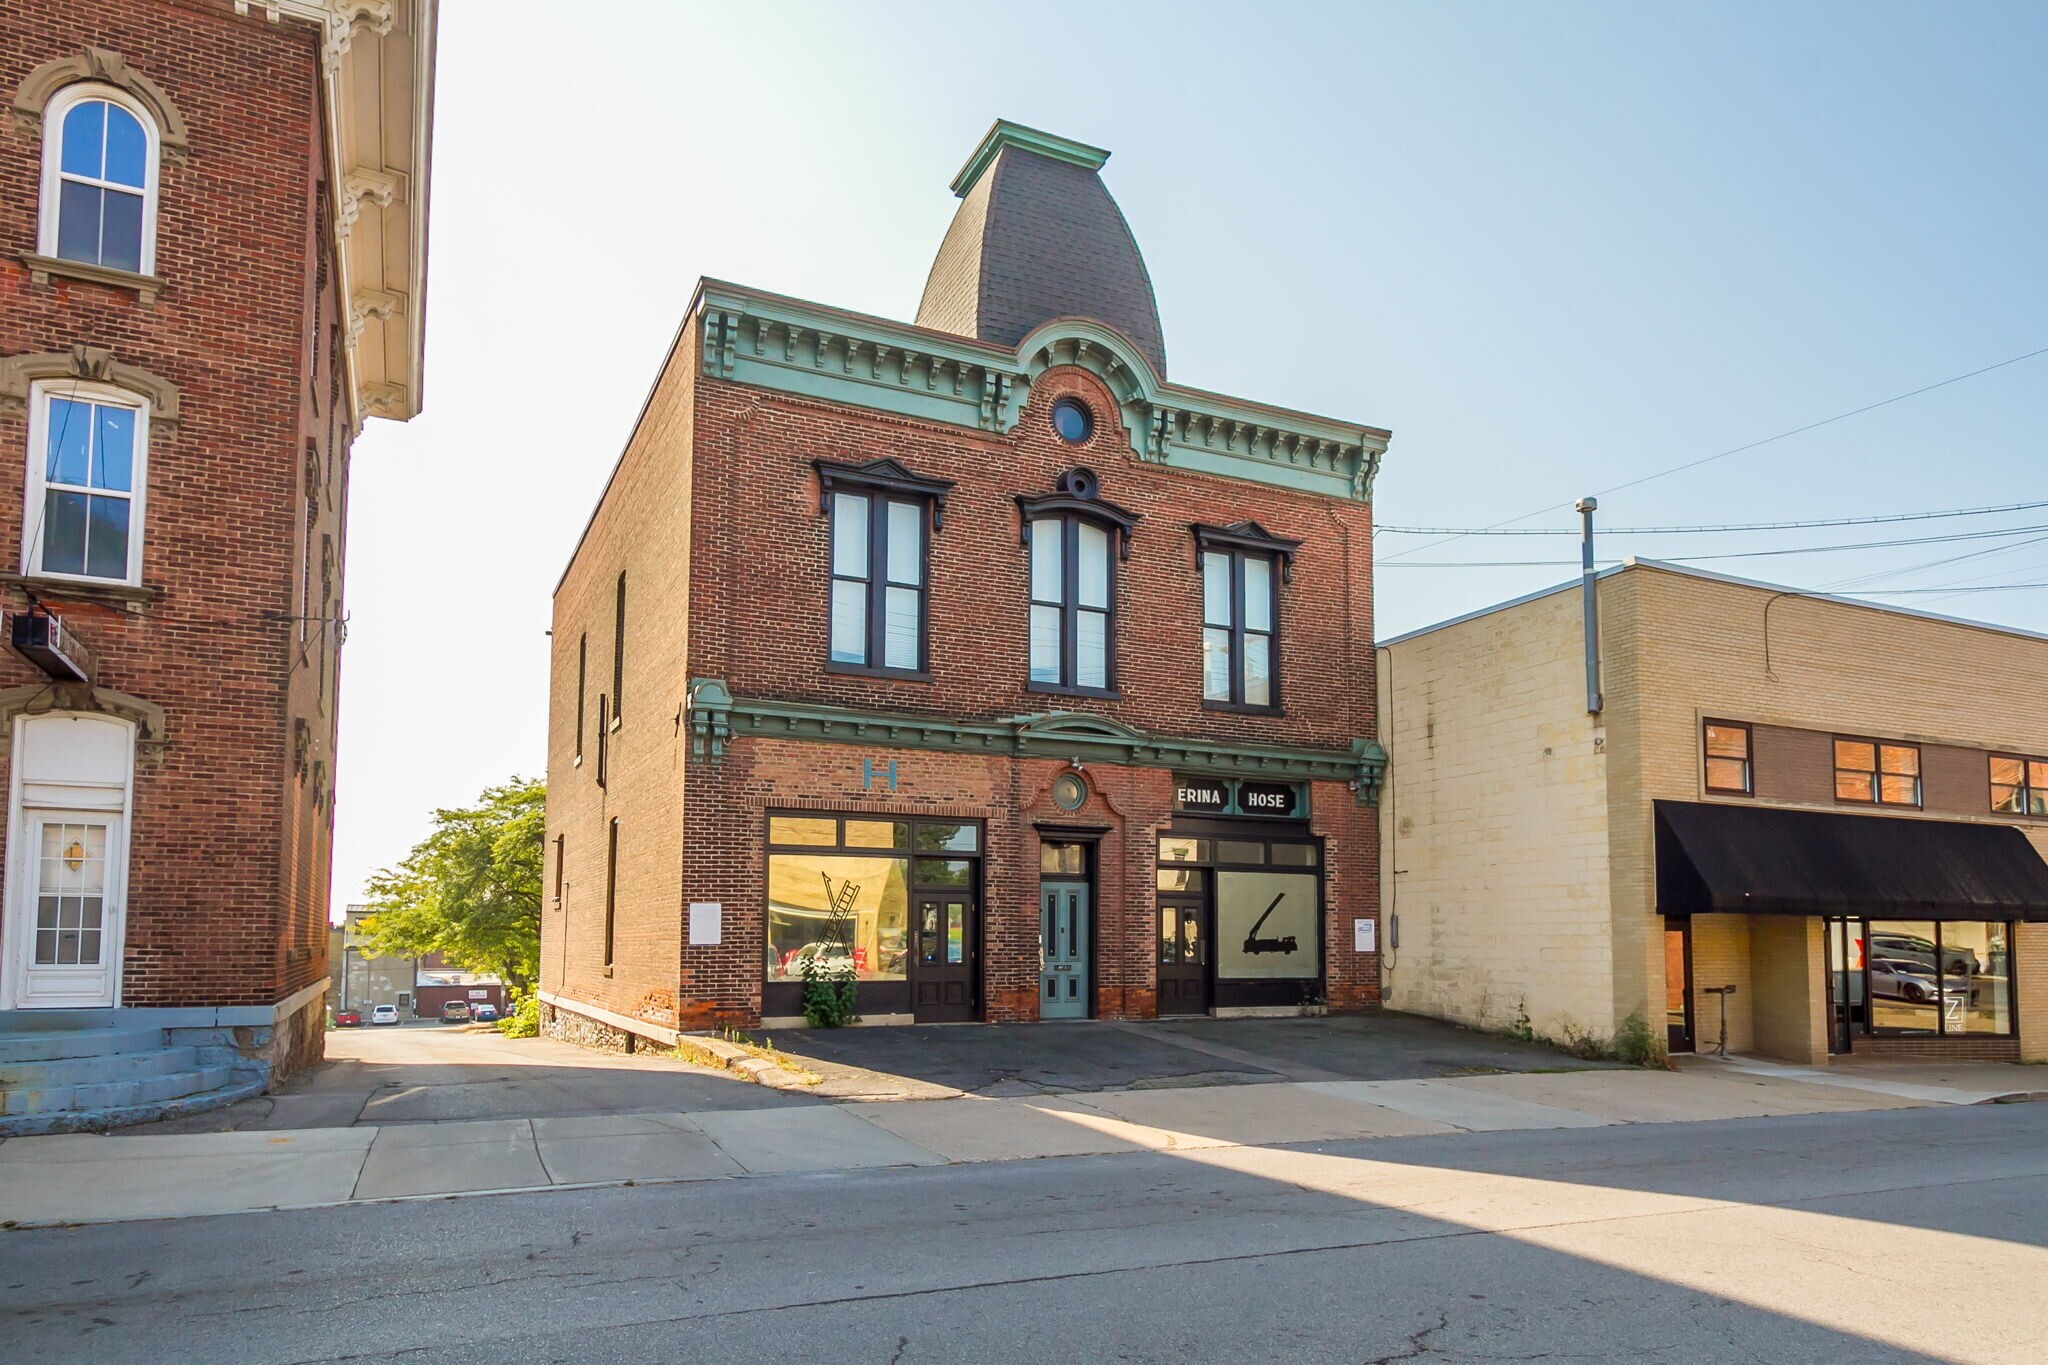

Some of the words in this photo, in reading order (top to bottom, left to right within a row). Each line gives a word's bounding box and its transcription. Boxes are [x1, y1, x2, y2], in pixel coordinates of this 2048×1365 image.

[864, 758, 896, 790] H
[1177, 788, 1220, 804] ERINA
[1248, 792, 1285, 808] HOSE
